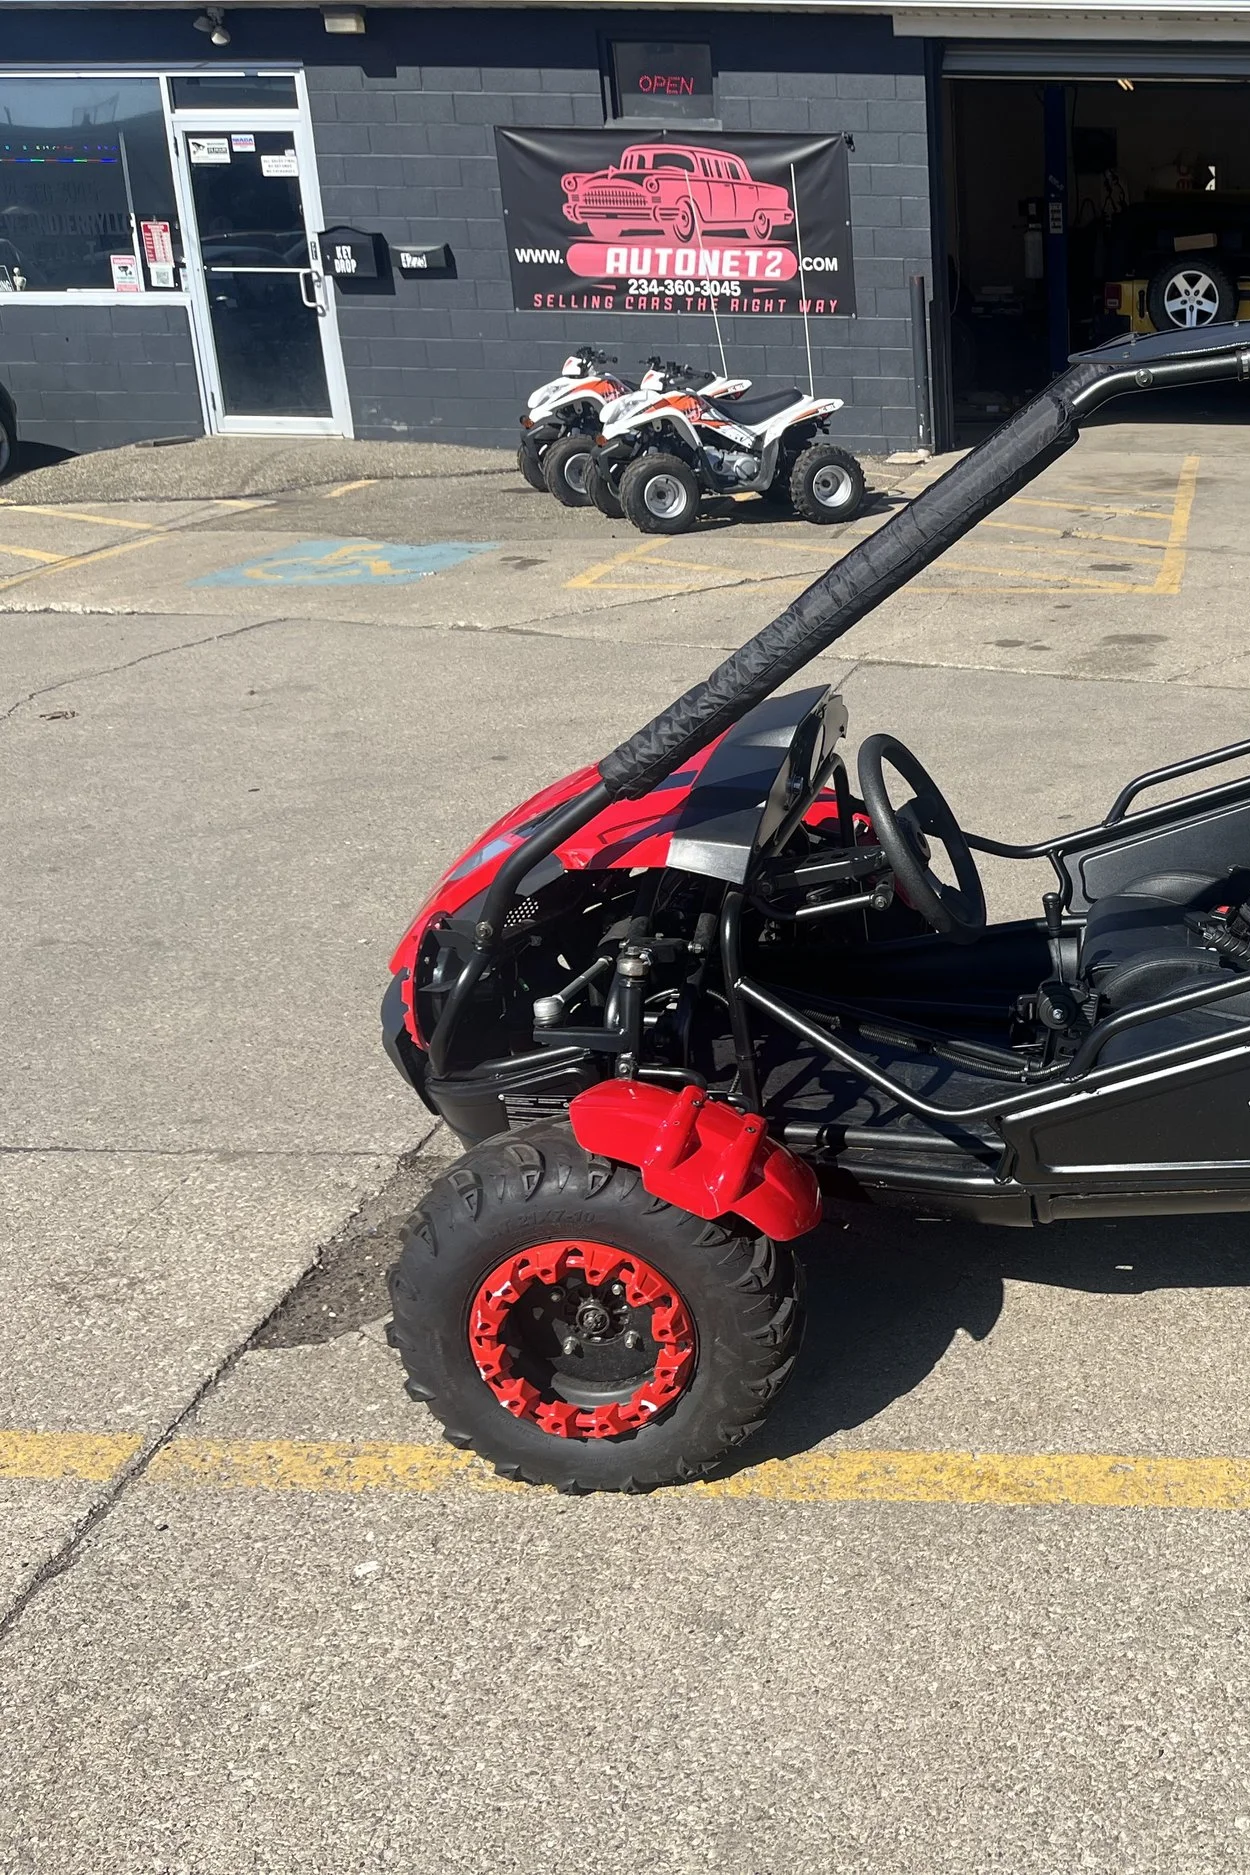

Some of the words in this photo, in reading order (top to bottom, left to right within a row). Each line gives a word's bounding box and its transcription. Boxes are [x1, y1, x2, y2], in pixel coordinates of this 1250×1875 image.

[639, 75, 694, 96] OPEN
[335, 245, 352, 260] KEY
[605, 247, 783, 278] AUTONET2
[333, 259, 357, 273] DROP
[628, 278, 741, 297] 234-360-3045
[533, 293, 613, 309] SELLING
[625, 297, 673, 311] CARS
[686, 298, 719, 312] THE
[730, 299, 787, 313] RIGHT
[799, 300, 838, 314] WAY
